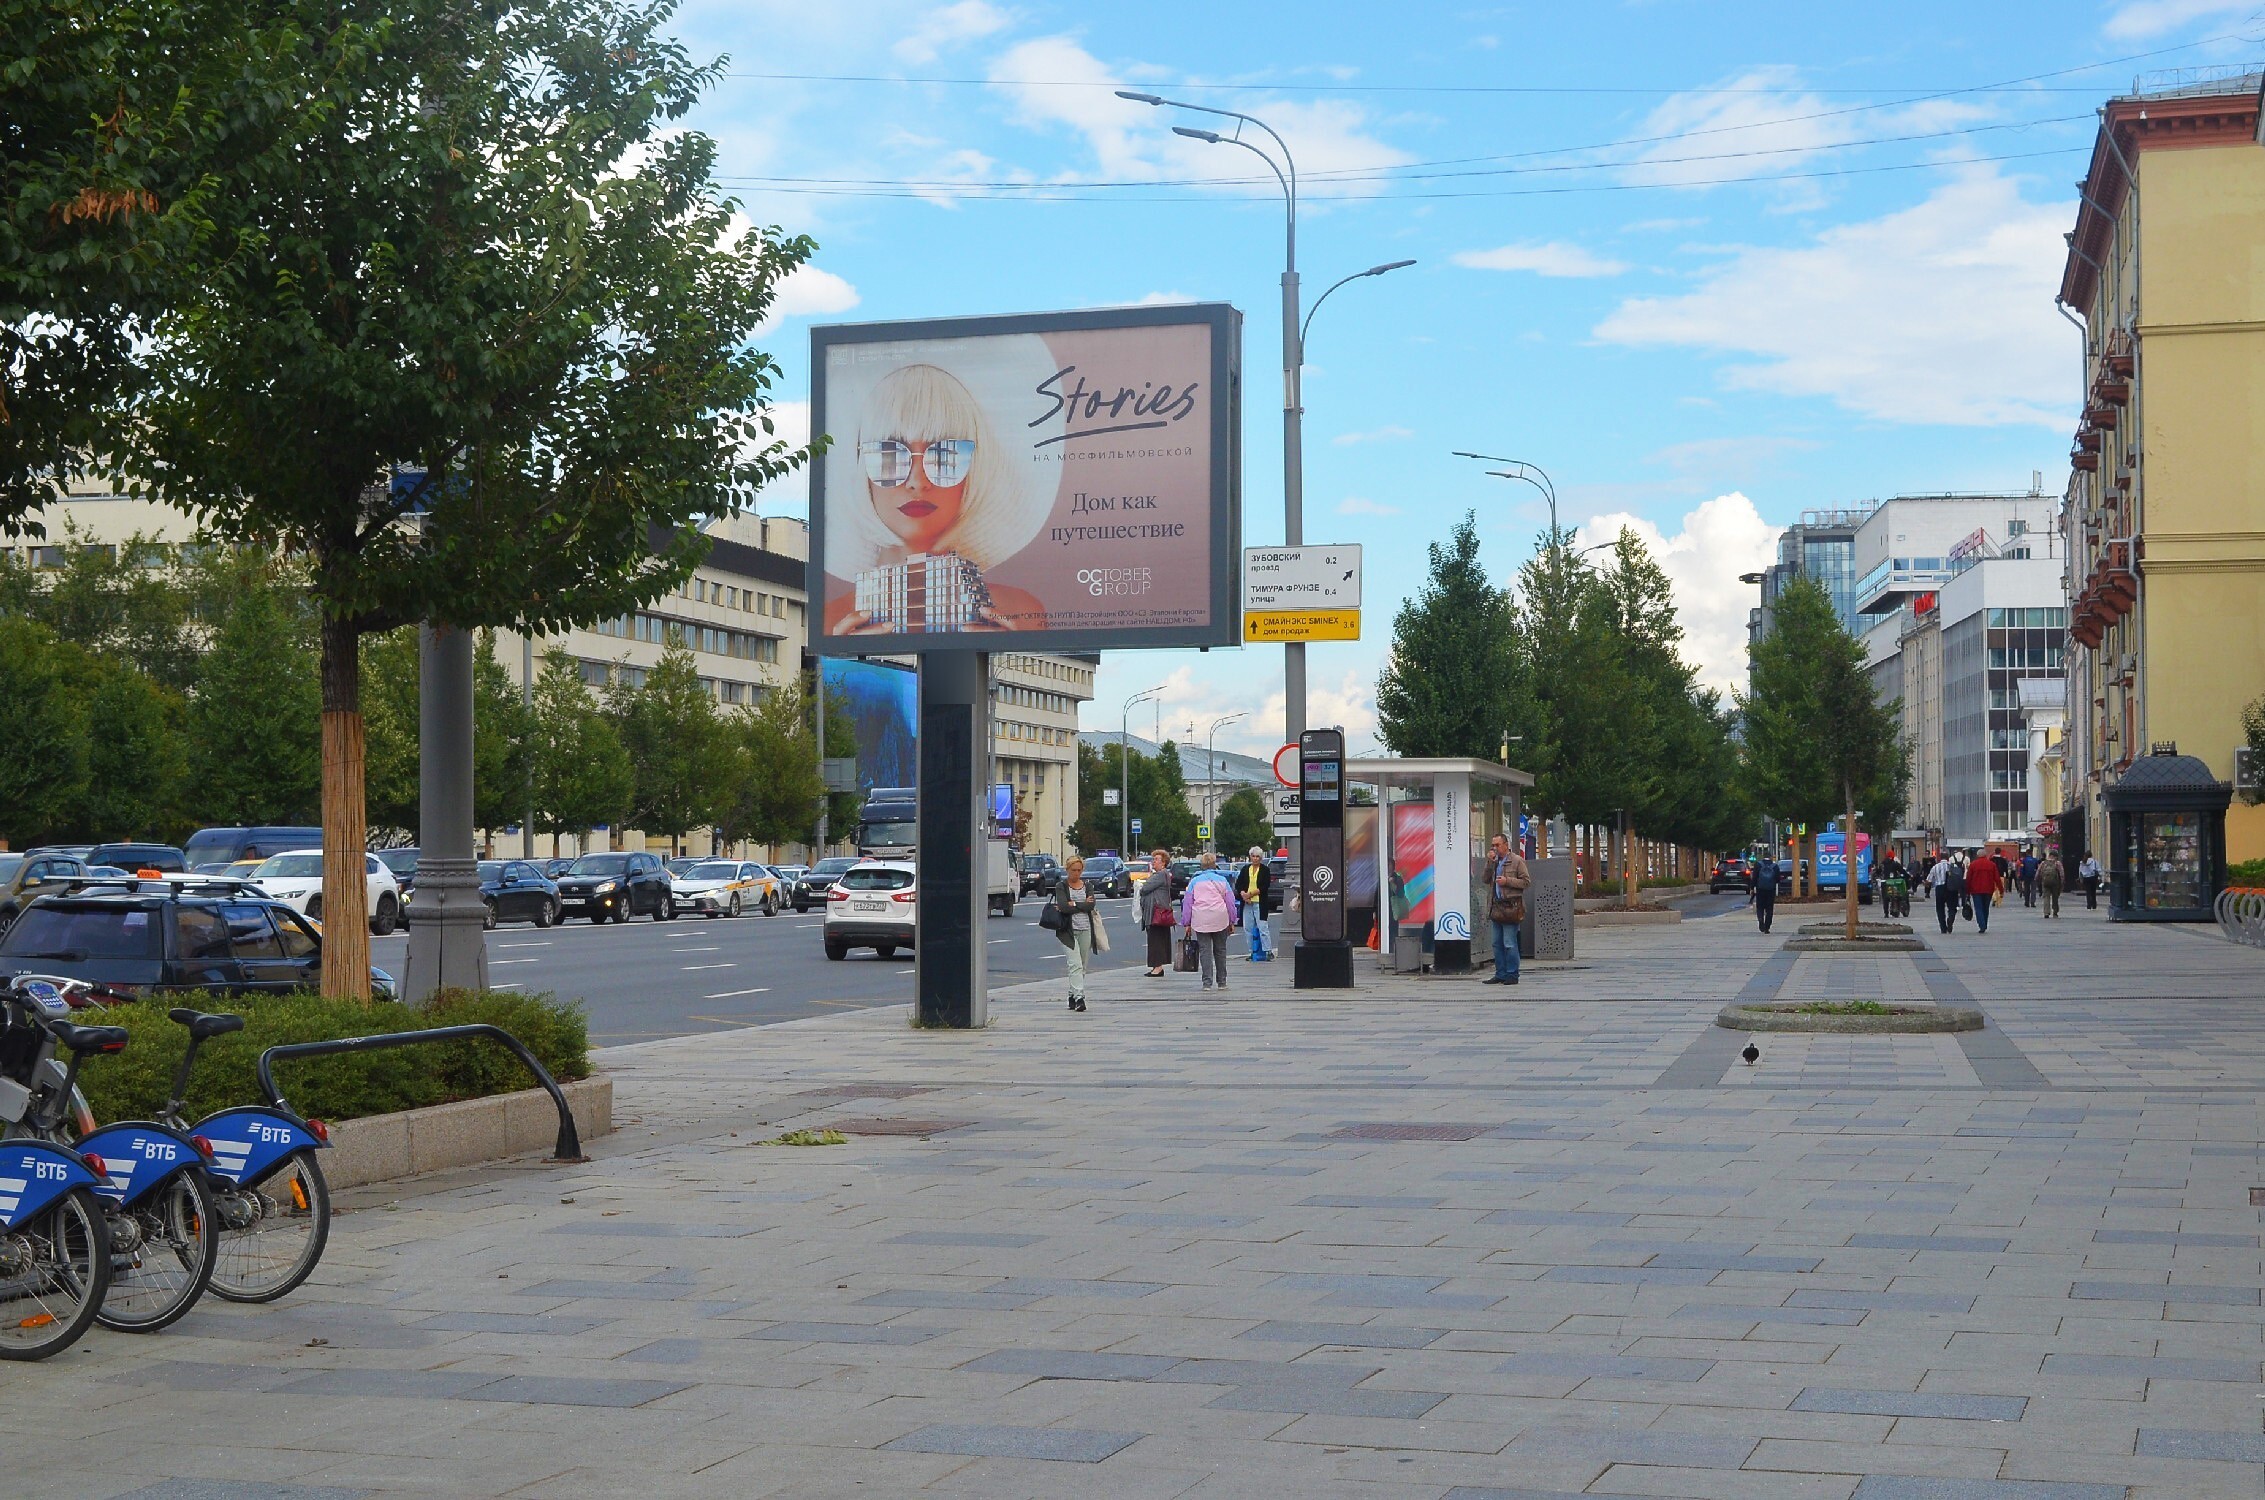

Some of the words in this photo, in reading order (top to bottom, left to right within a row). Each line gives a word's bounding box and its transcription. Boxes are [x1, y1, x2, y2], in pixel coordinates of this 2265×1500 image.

[1027, 365, 1199, 429] Stories
[1033, 454, 1051, 463] НА
[1057, 447, 1192, 462] МОСФИЛЬМОВСКОЙ
[1071, 491, 1118, 515] Дом
[1121, 494, 1158, 511] как
[1050, 519, 1185, 546] путешествие
[1251, 552, 1301, 563] ЗУБОВСКИЙ
[1325, 556, 1337, 565] 0.2
[1077, 567, 1152, 584] OCTOBER
[1251, 564, 1280, 572] проезд
[1088, 582, 1152, 596] GROUP
[1250, 584, 1284, 594] ТИМУРА
[1286, 583, 1320, 593] ФРУНЗЕ
[1324, 588, 1337, 597] 0.4
[1250, 596, 1276, 604] улица
[1263, 616, 1307, 626] СМАЙНЭКС
[1308, 617, 1339, 626] SMINEX
[1263, 628, 1279, 636] дом
[1280, 628, 1310, 637] продаж
[1819, 854, 1864, 865] OZON
[261, 1126, 291, 1145] ВТБ
[145, 1141, 176, 1161] ВТБ
[36, 1162, 68, 1182] ВТБ
